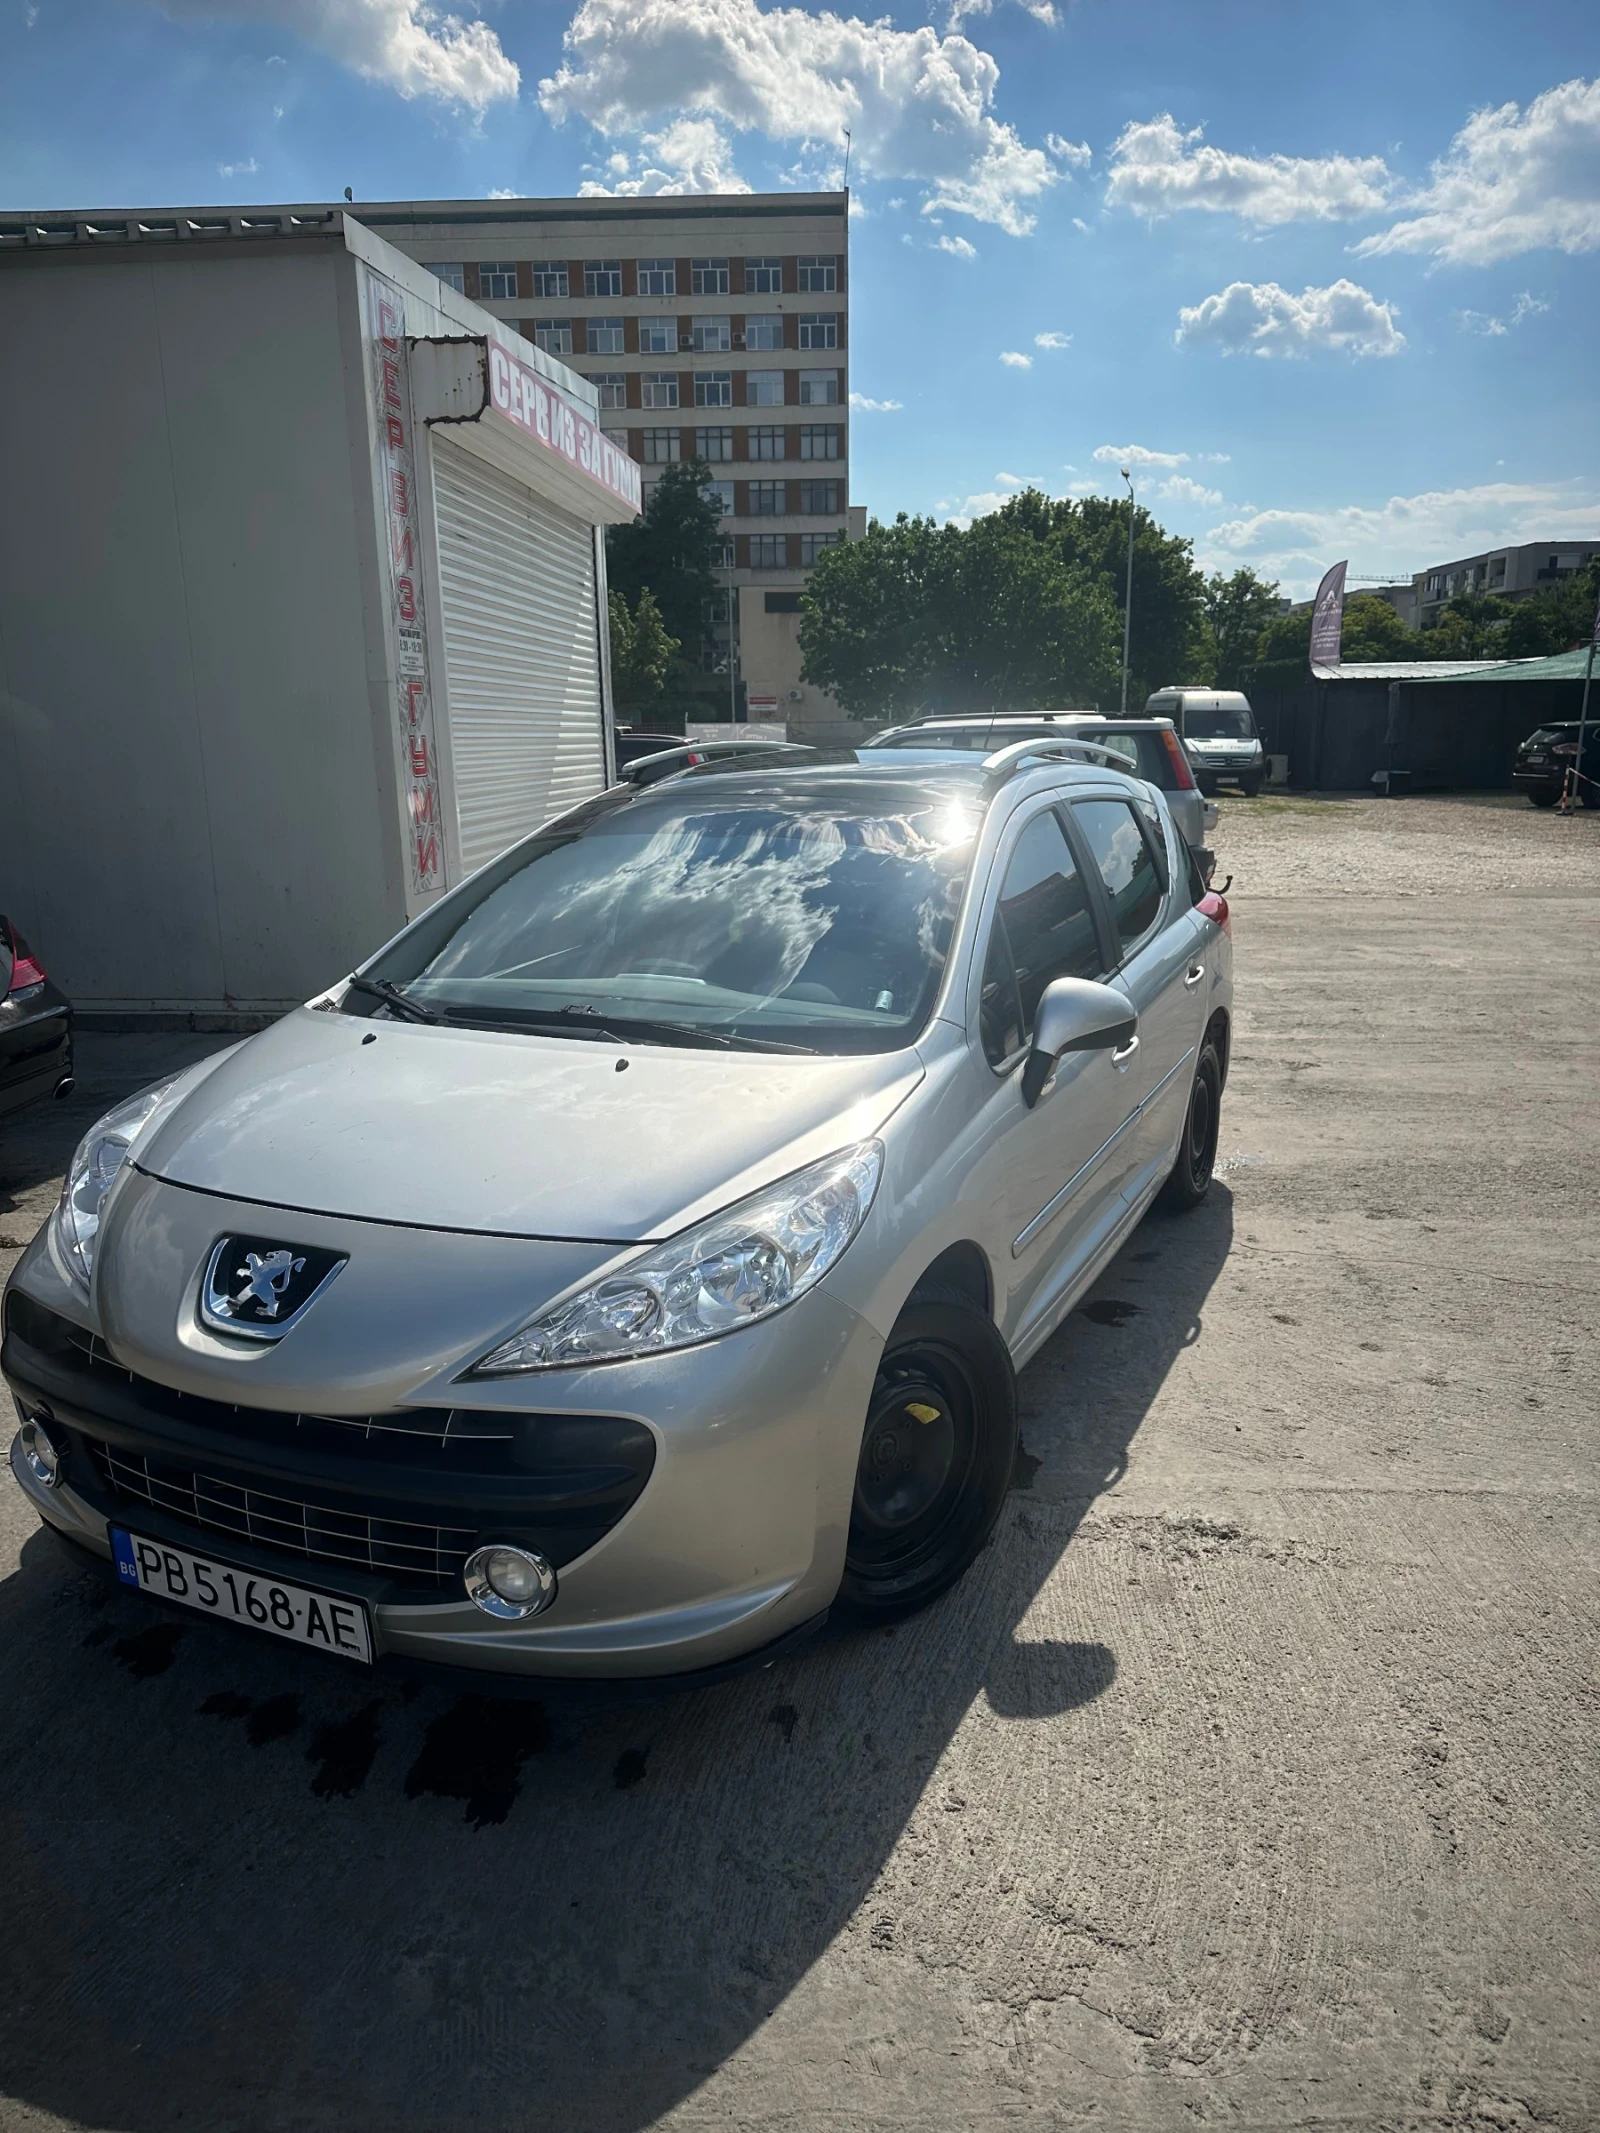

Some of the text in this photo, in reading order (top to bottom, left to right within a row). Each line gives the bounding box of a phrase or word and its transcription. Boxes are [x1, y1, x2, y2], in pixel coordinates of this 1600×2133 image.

[491, 347, 641, 508] СЕРВИЗ ЗА ГУМИ
[379, 299, 416, 621] СЕРВИЗ
[408, 681, 438, 877] ГУМИ
[120, 1561, 136, 1577] BG
